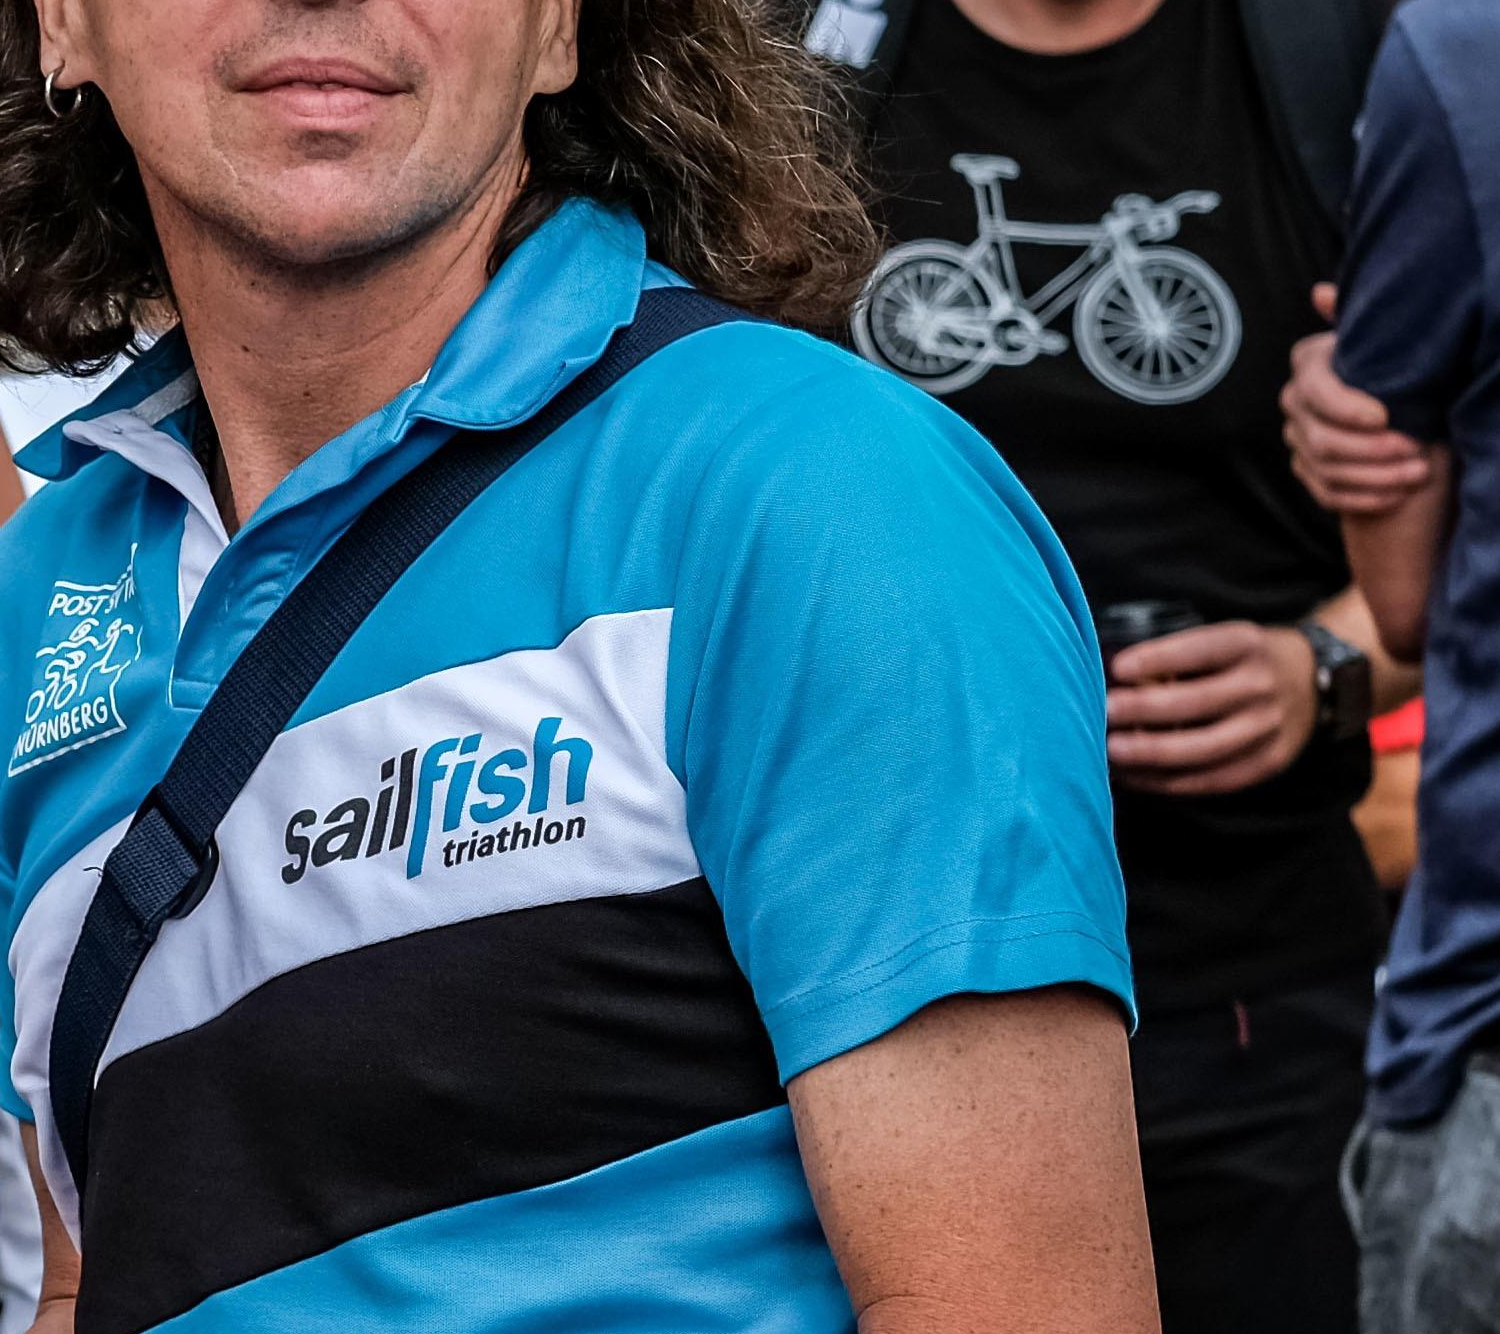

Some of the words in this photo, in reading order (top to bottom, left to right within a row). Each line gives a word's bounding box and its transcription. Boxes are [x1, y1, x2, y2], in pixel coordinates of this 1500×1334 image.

[49, 593, 108, 616] POST
[13, 696, 109, 758] NÜRNBERG
[281, 716, 595, 885] sailfish
[442, 816, 587, 870] triathlon
